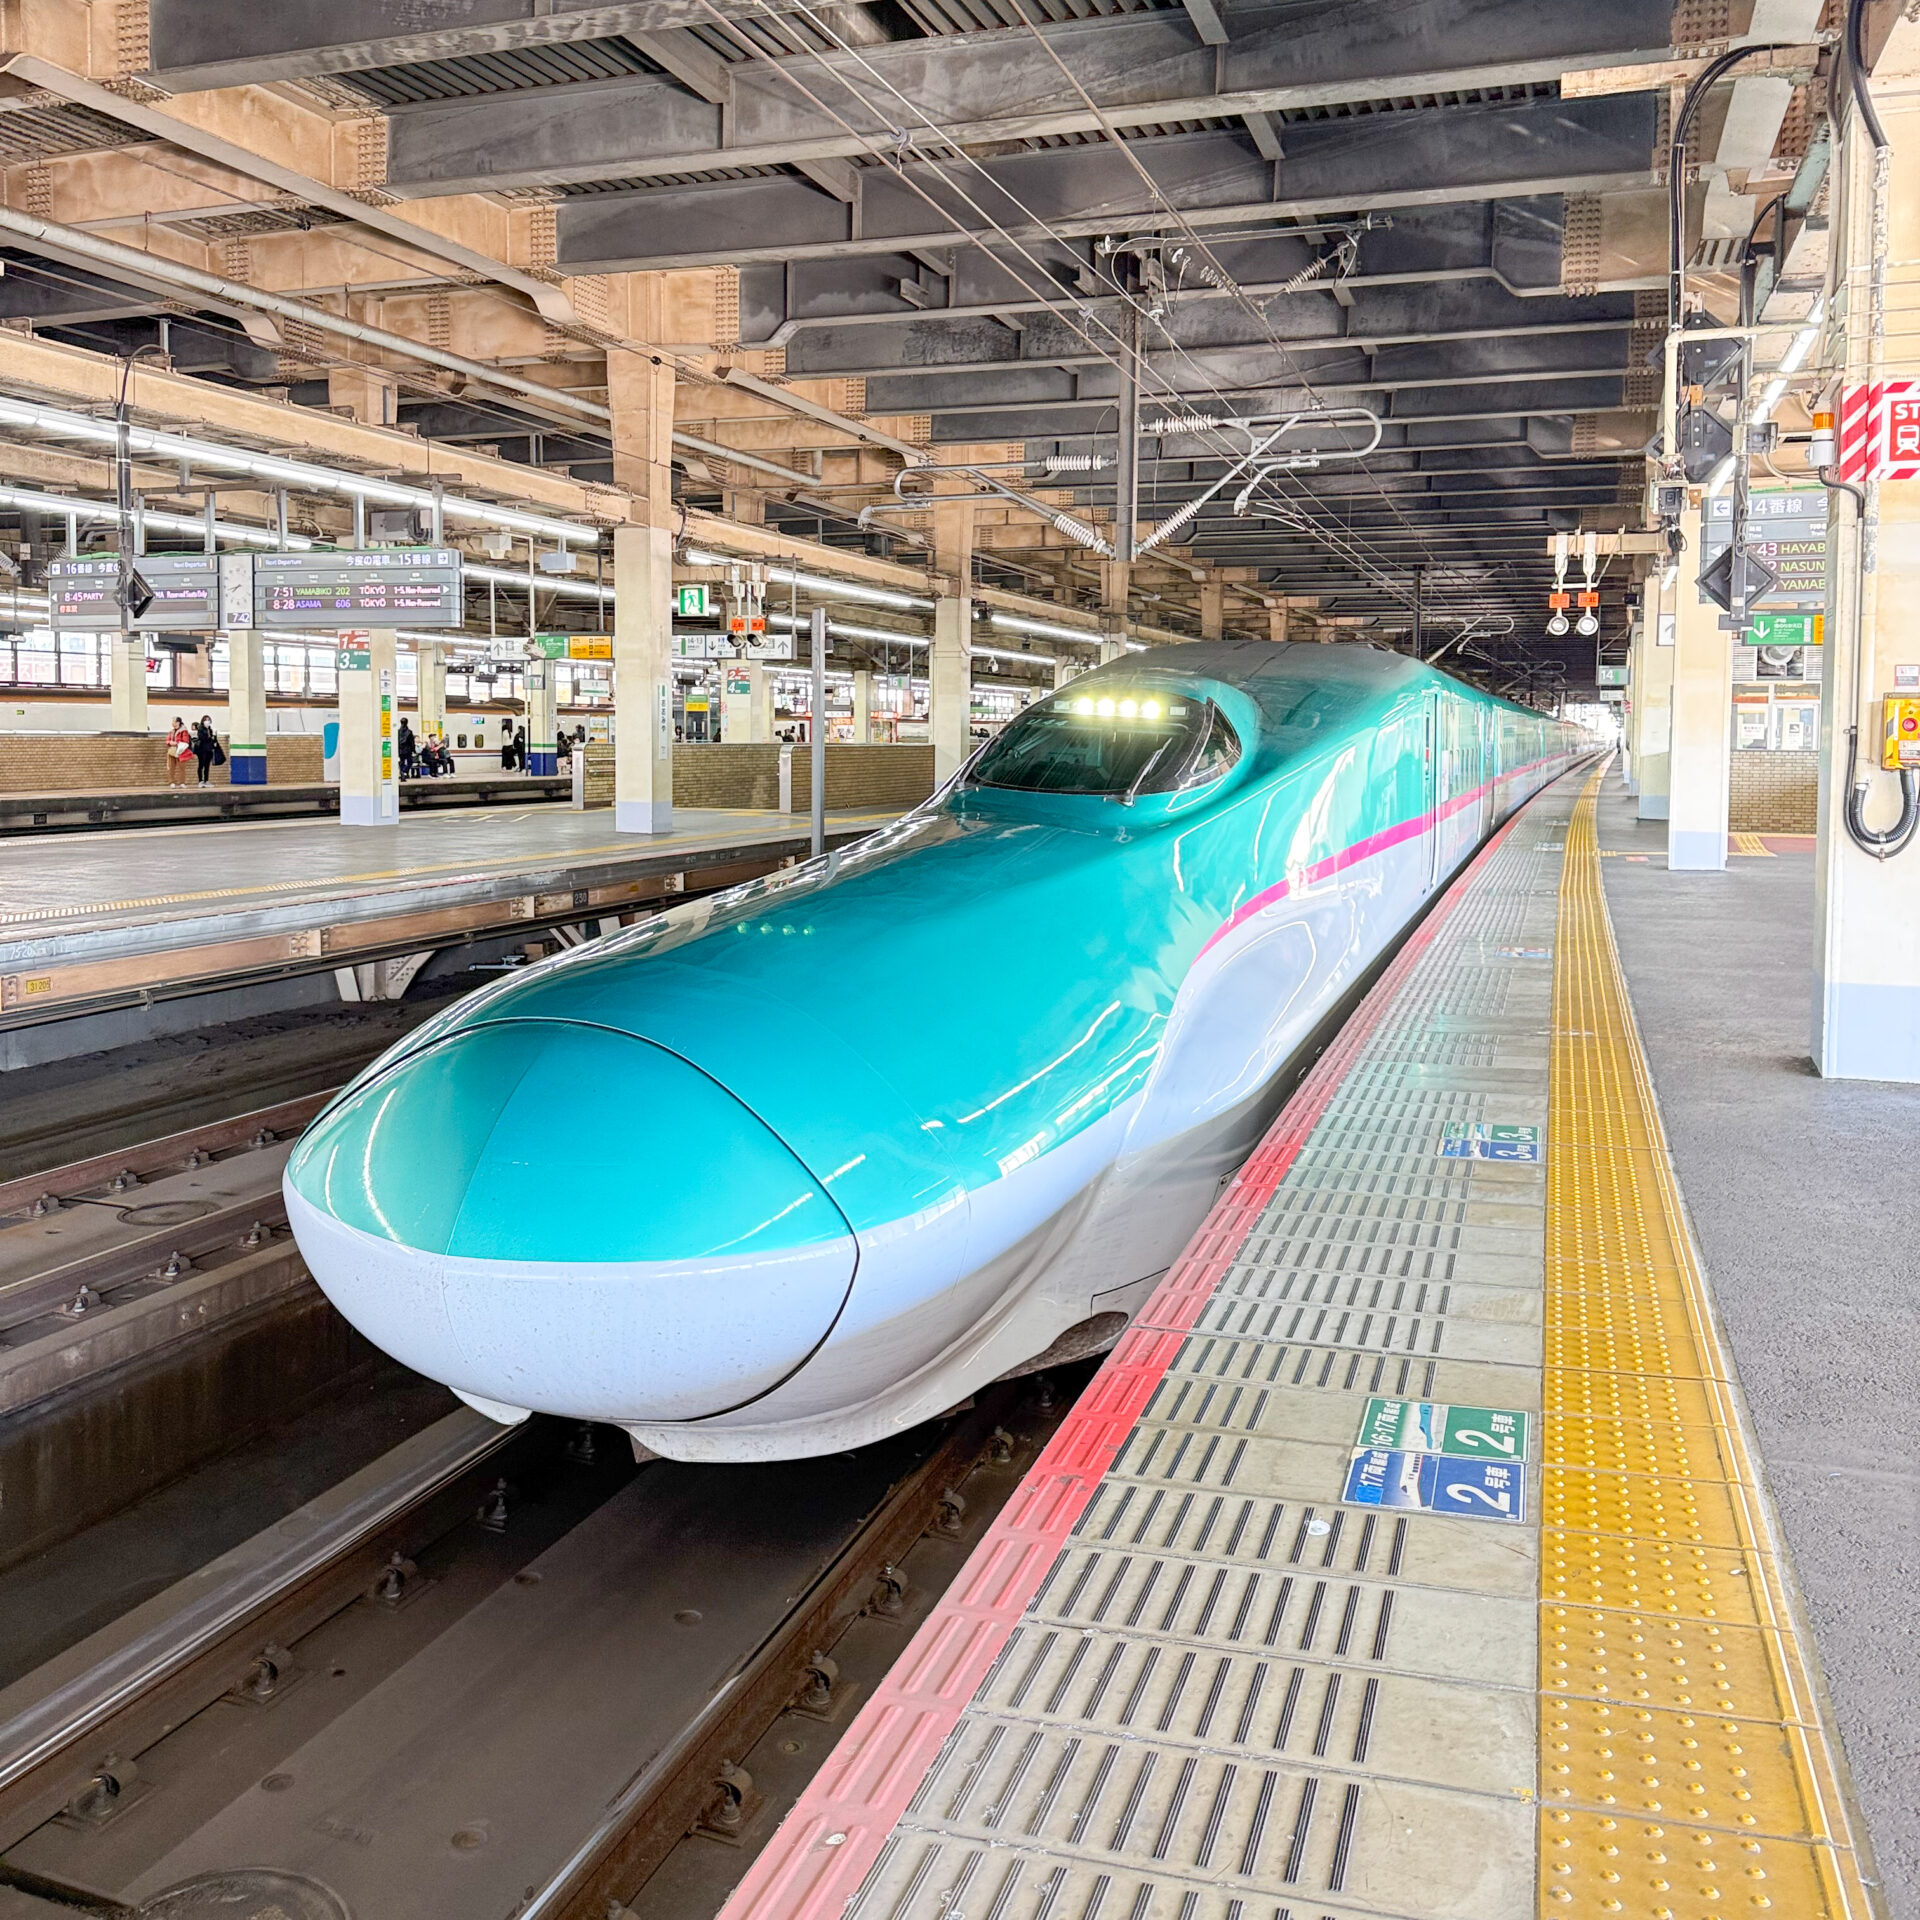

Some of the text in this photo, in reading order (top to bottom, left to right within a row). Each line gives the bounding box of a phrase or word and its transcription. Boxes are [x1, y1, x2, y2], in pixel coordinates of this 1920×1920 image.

[1748, 499, 1802, 516] 14番線
[399, 554, 431, 565] 15番線
[66, 563, 92, 574] 16番線
[64, 592, 104, 602] 8:45 PARTY
[273, 587, 293, 597] 7:51
[295, 587, 332, 596] YAMABIKO
[335, 586, 350, 596] 202
[272, 599, 295, 610] 8:28
[296, 600, 322, 608] ASAMA
[335, 599, 350, 608] 606
[1600, 669, 1615, 682] 14
